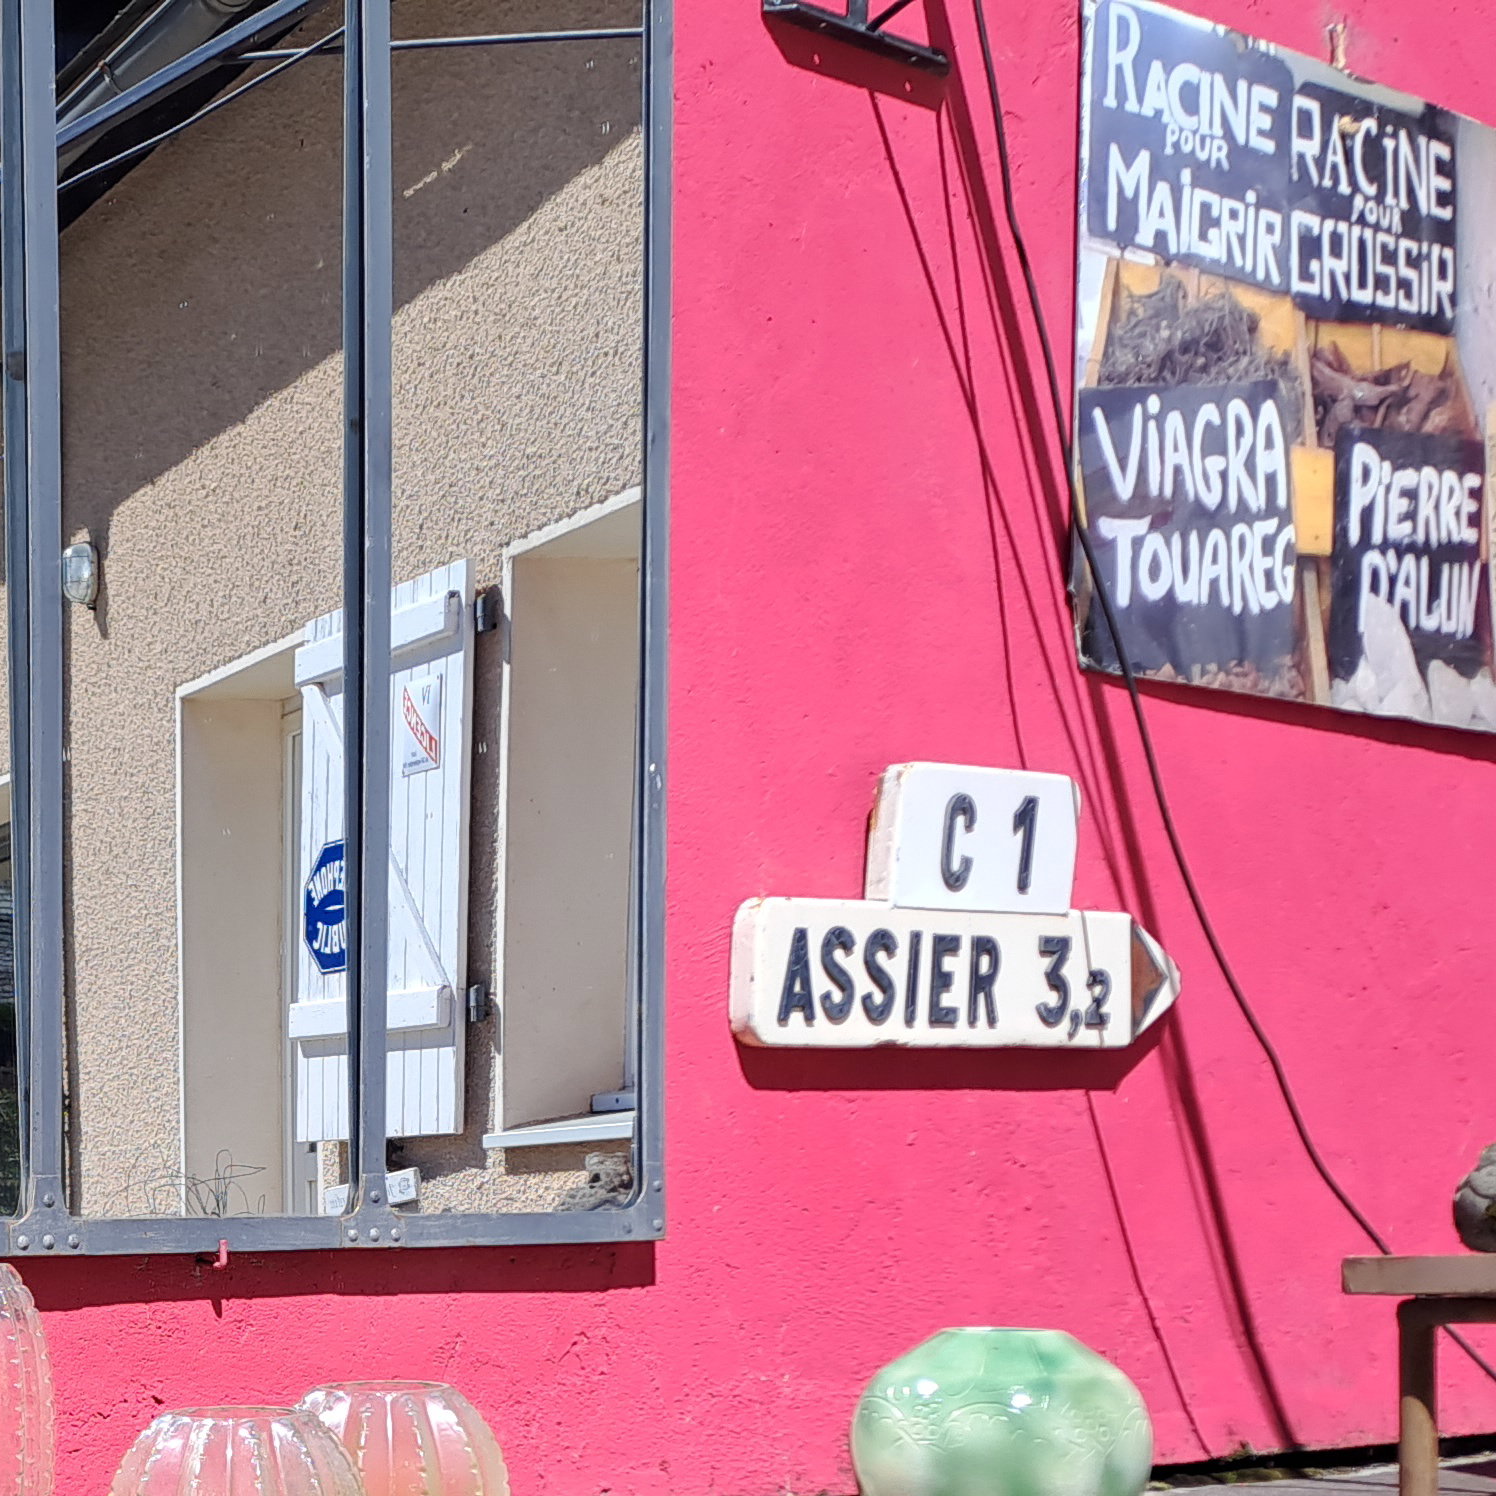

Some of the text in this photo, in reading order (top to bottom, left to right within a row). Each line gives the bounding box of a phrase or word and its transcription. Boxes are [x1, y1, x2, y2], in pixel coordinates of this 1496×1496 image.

[1103, 4, 1278, 155] RACINE
[1164, 126, 1229, 171] POUR
[1351, 194, 1403, 235] POUR
[1097, 514, 1296, 615] TOUAREG
[941, 792, 1040, 895] C 1
[776, 926, 1002, 1030] ASSIER
